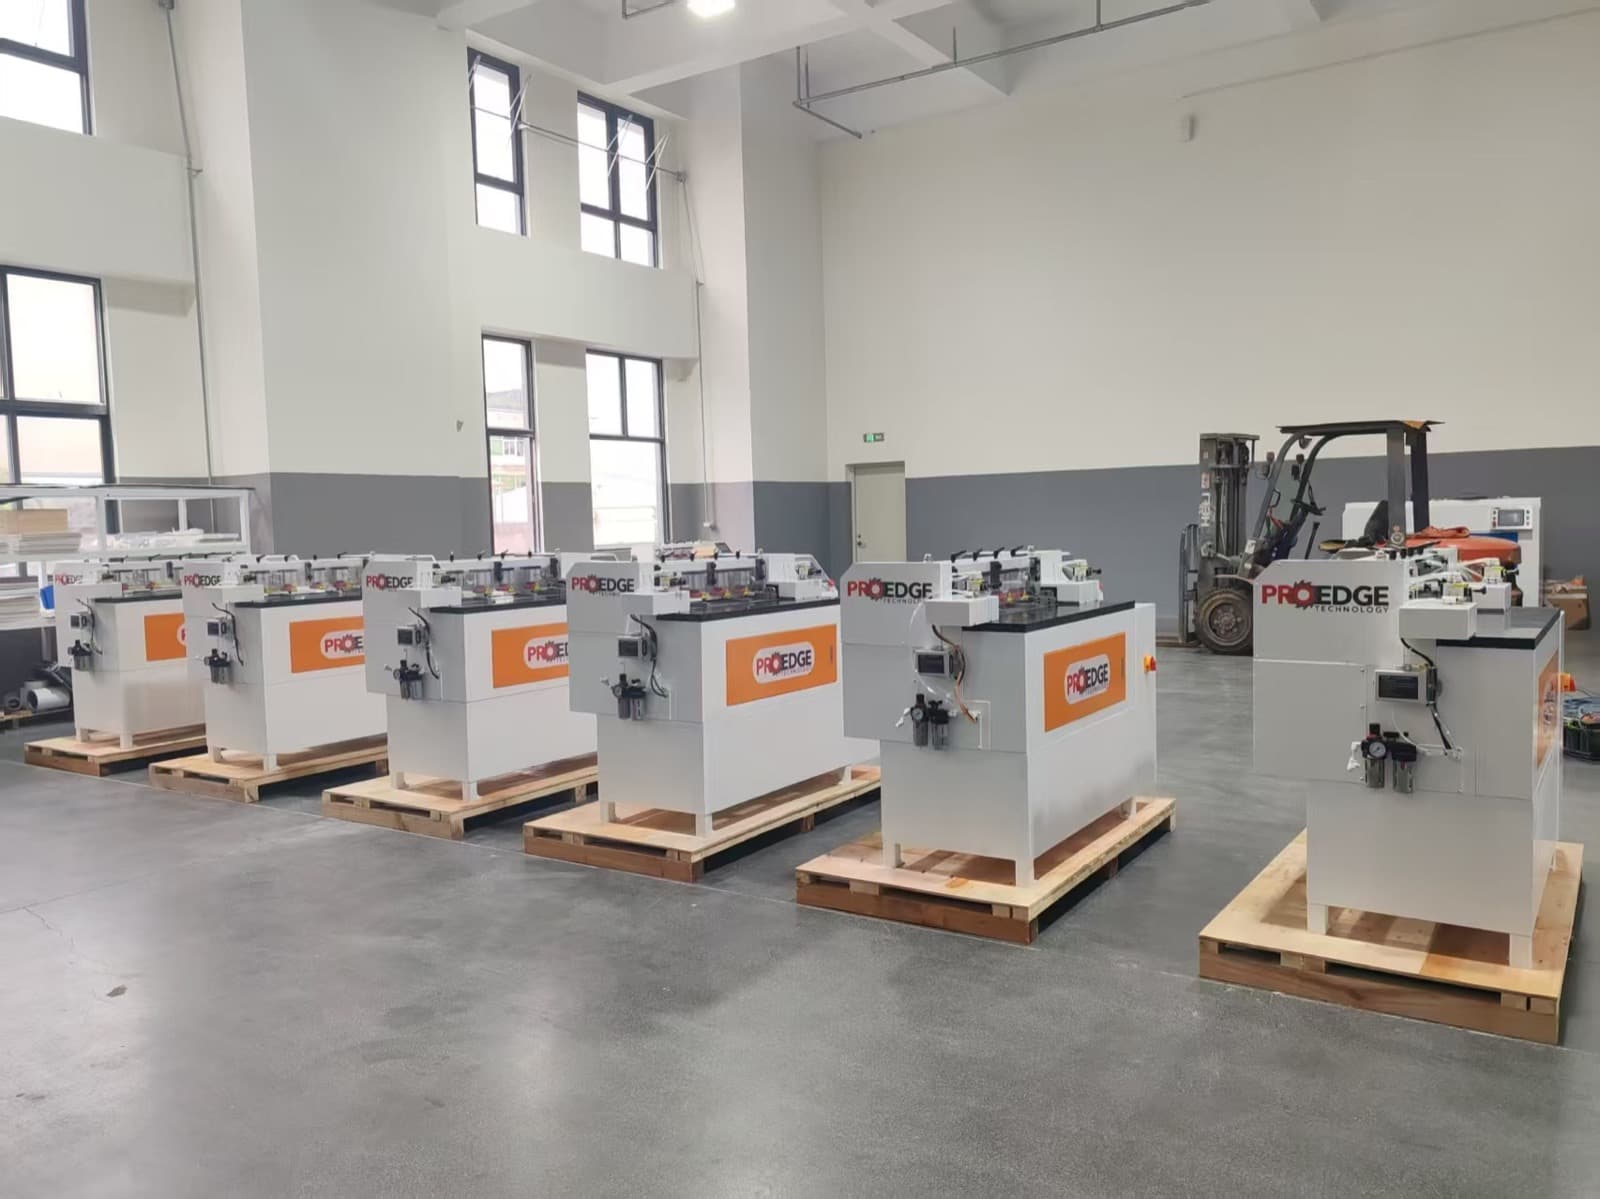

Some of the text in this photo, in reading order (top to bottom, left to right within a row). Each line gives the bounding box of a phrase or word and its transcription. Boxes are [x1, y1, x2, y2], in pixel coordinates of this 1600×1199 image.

[571, 575, 635, 594] PROEDGE
[847, 577, 933, 601] PROEDGE
[1261, 580, 1390, 610] PROEDGE
[1314, 605, 1390, 614] TECHNOLOGY
[324, 634, 364, 653] PROE
[756, 649, 812, 677] PROEDGE
[1066, 663, 1109, 697] PROEDGE
